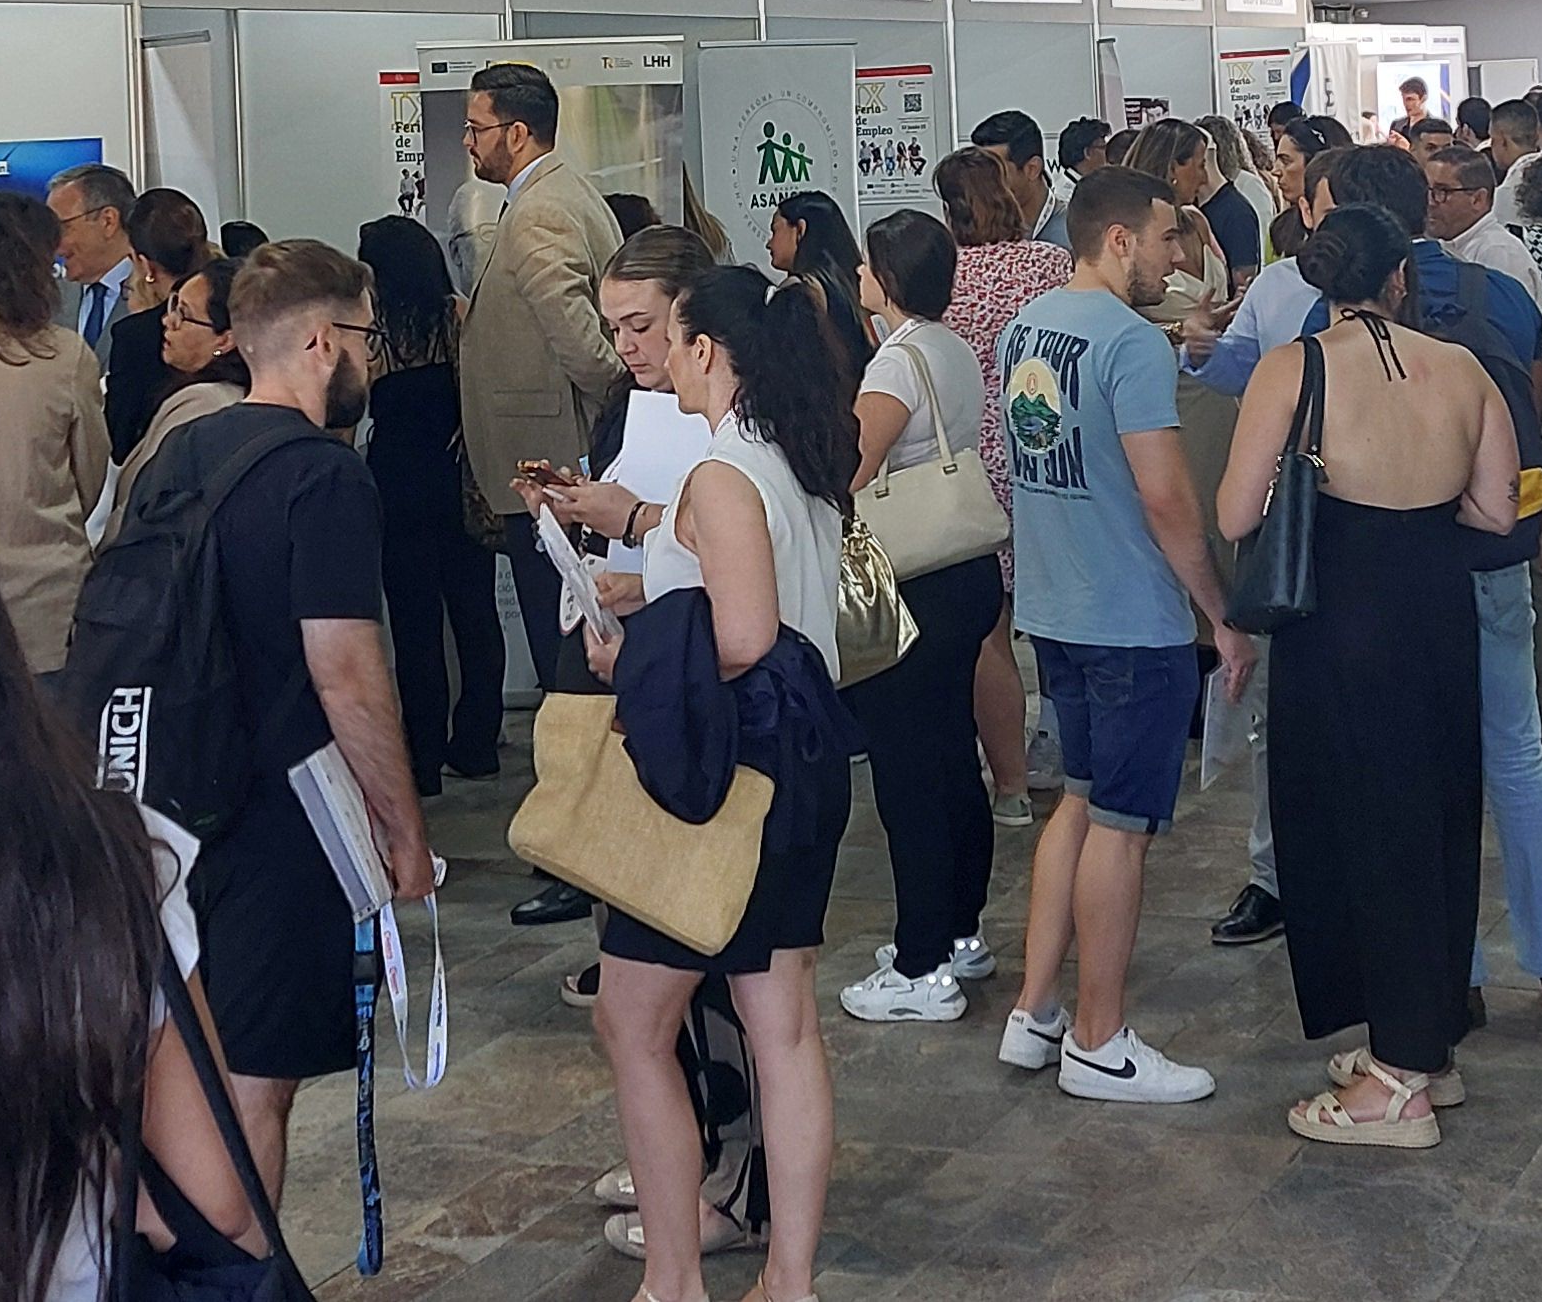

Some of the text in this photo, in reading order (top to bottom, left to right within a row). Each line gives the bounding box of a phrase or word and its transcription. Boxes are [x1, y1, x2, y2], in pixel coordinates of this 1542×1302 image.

[643, 56, 671, 68] LHH
[1231, 93, 1260, 102] Empleo
[395, 121, 420, 133] Feri
[856, 125, 893, 138] Empleo
[395, 135, 410, 147] de
[395, 151, 424, 164] Emp
[1032, 328, 1090, 411] YOUR
[107, 687, 143, 794] UNICH
